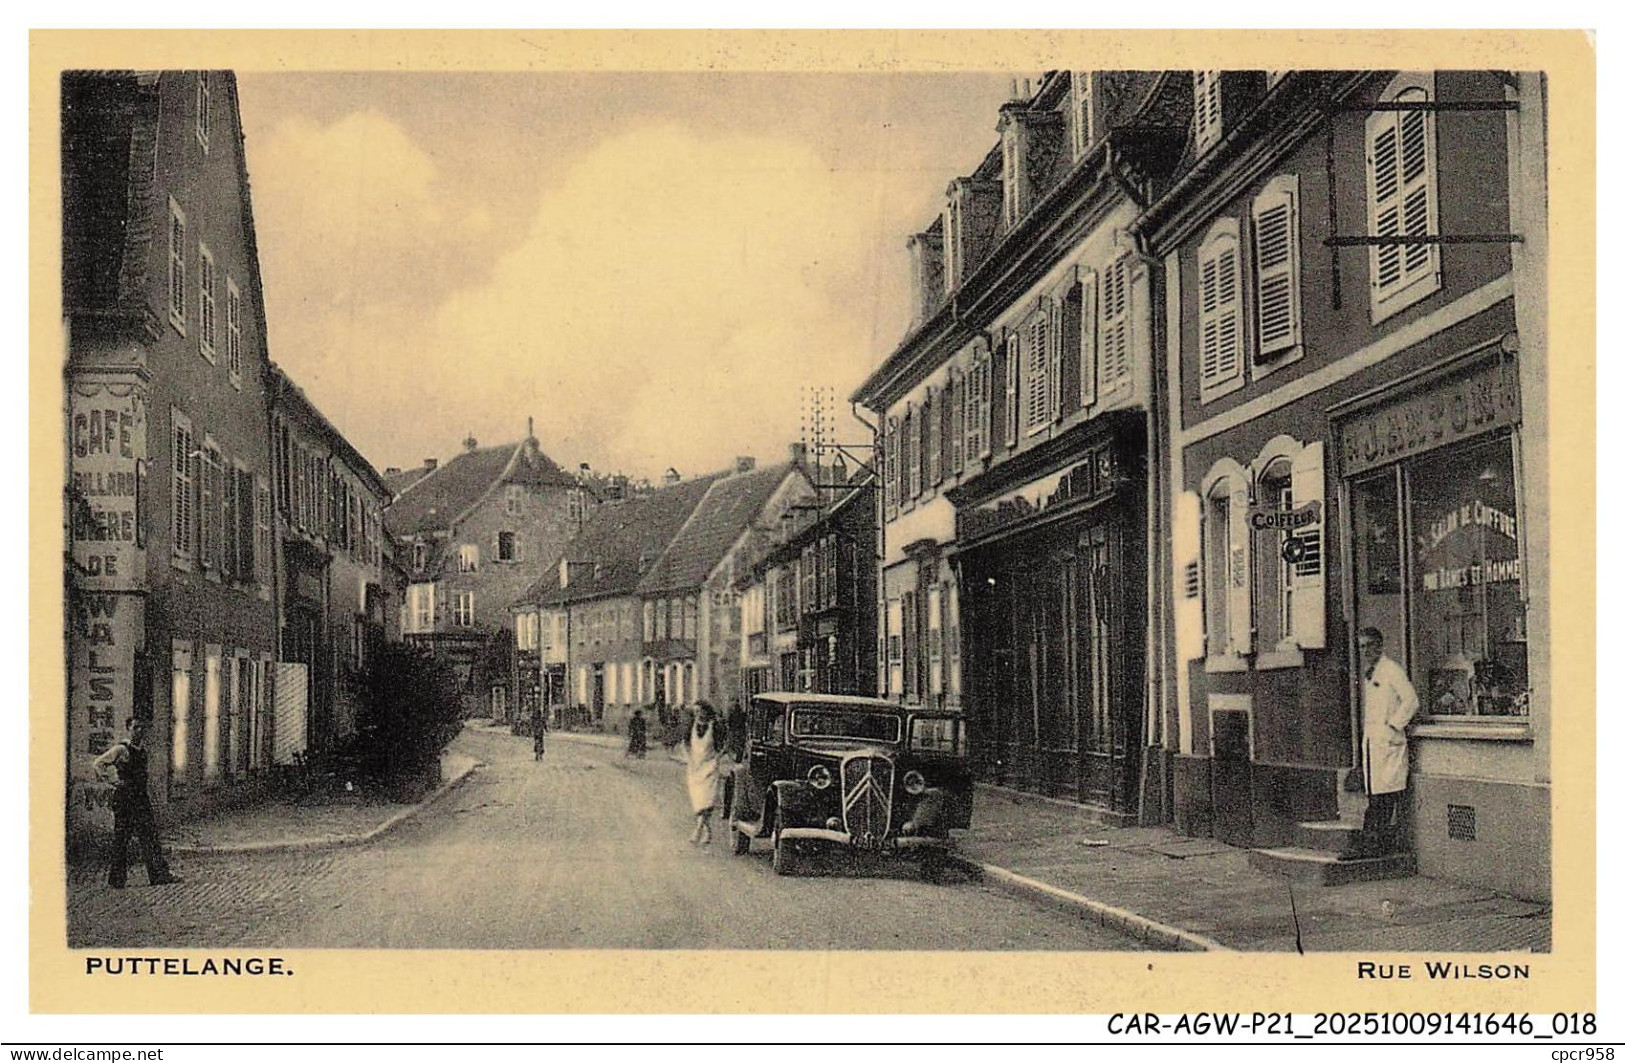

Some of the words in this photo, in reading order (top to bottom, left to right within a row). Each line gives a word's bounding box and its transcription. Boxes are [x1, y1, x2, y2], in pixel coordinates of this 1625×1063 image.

[74, 408, 133, 458] CAFÉ
[88, 555, 118, 577] DE
[85, 595, 118, 811] WALSHEM
